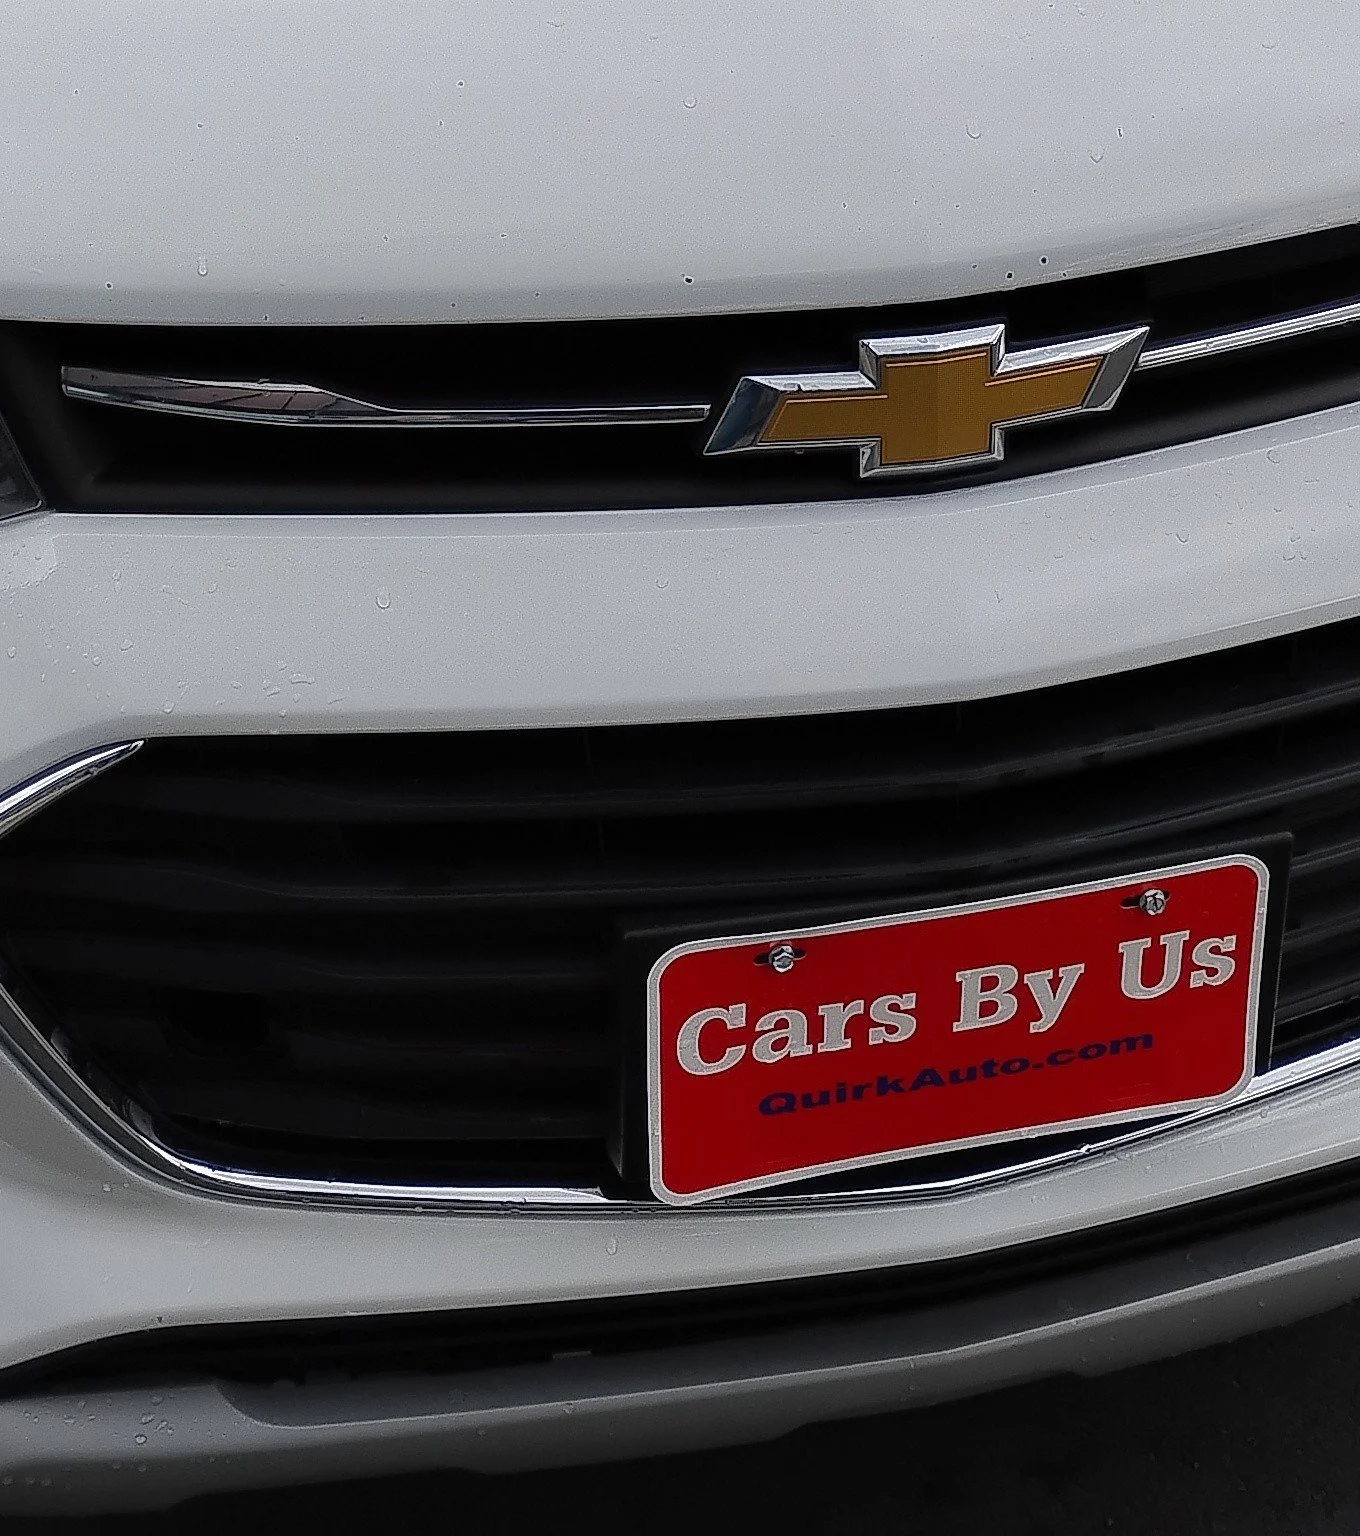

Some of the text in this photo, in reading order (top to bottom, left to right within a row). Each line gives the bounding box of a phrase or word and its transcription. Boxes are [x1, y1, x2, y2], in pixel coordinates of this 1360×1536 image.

[676, 929, 1238, 1077] Cars By Us
[757, 1031, 1156, 1116] QuirkAuto.com
